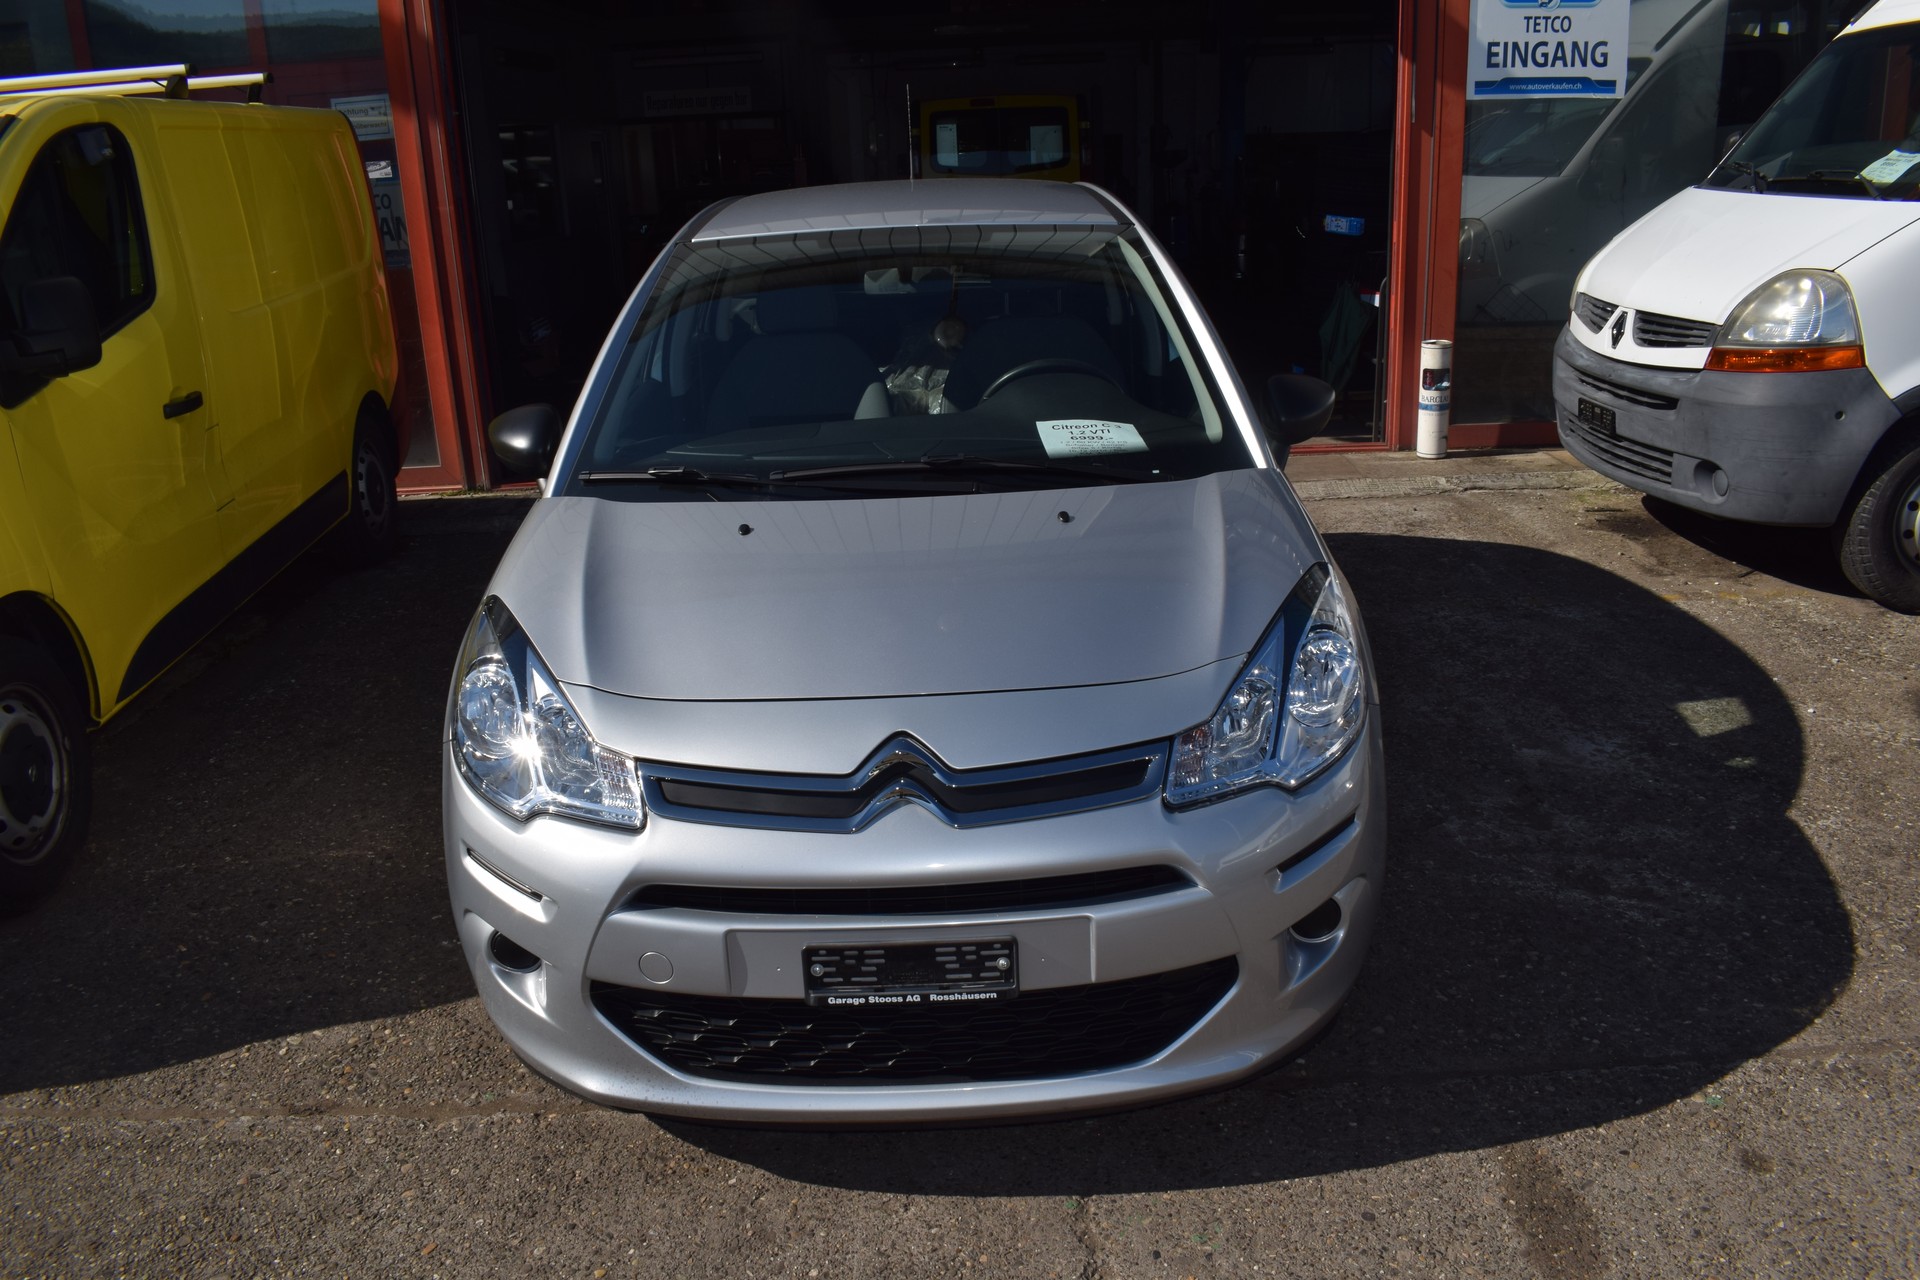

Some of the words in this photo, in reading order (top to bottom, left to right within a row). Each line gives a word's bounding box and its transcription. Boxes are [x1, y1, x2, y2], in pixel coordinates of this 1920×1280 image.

[1524, 15, 1572, 33] TETCO
[1486, 40, 1609, 68] EINGANG
[1509, 81, 1582, 91] www.autoverkaufen.ch
[828, 996, 866, 1005] Garage
[868, 995, 903, 1004] Stooss
[906, 994, 921, 1003] AG
[930, 992, 997, 1002] Rosshäusern
